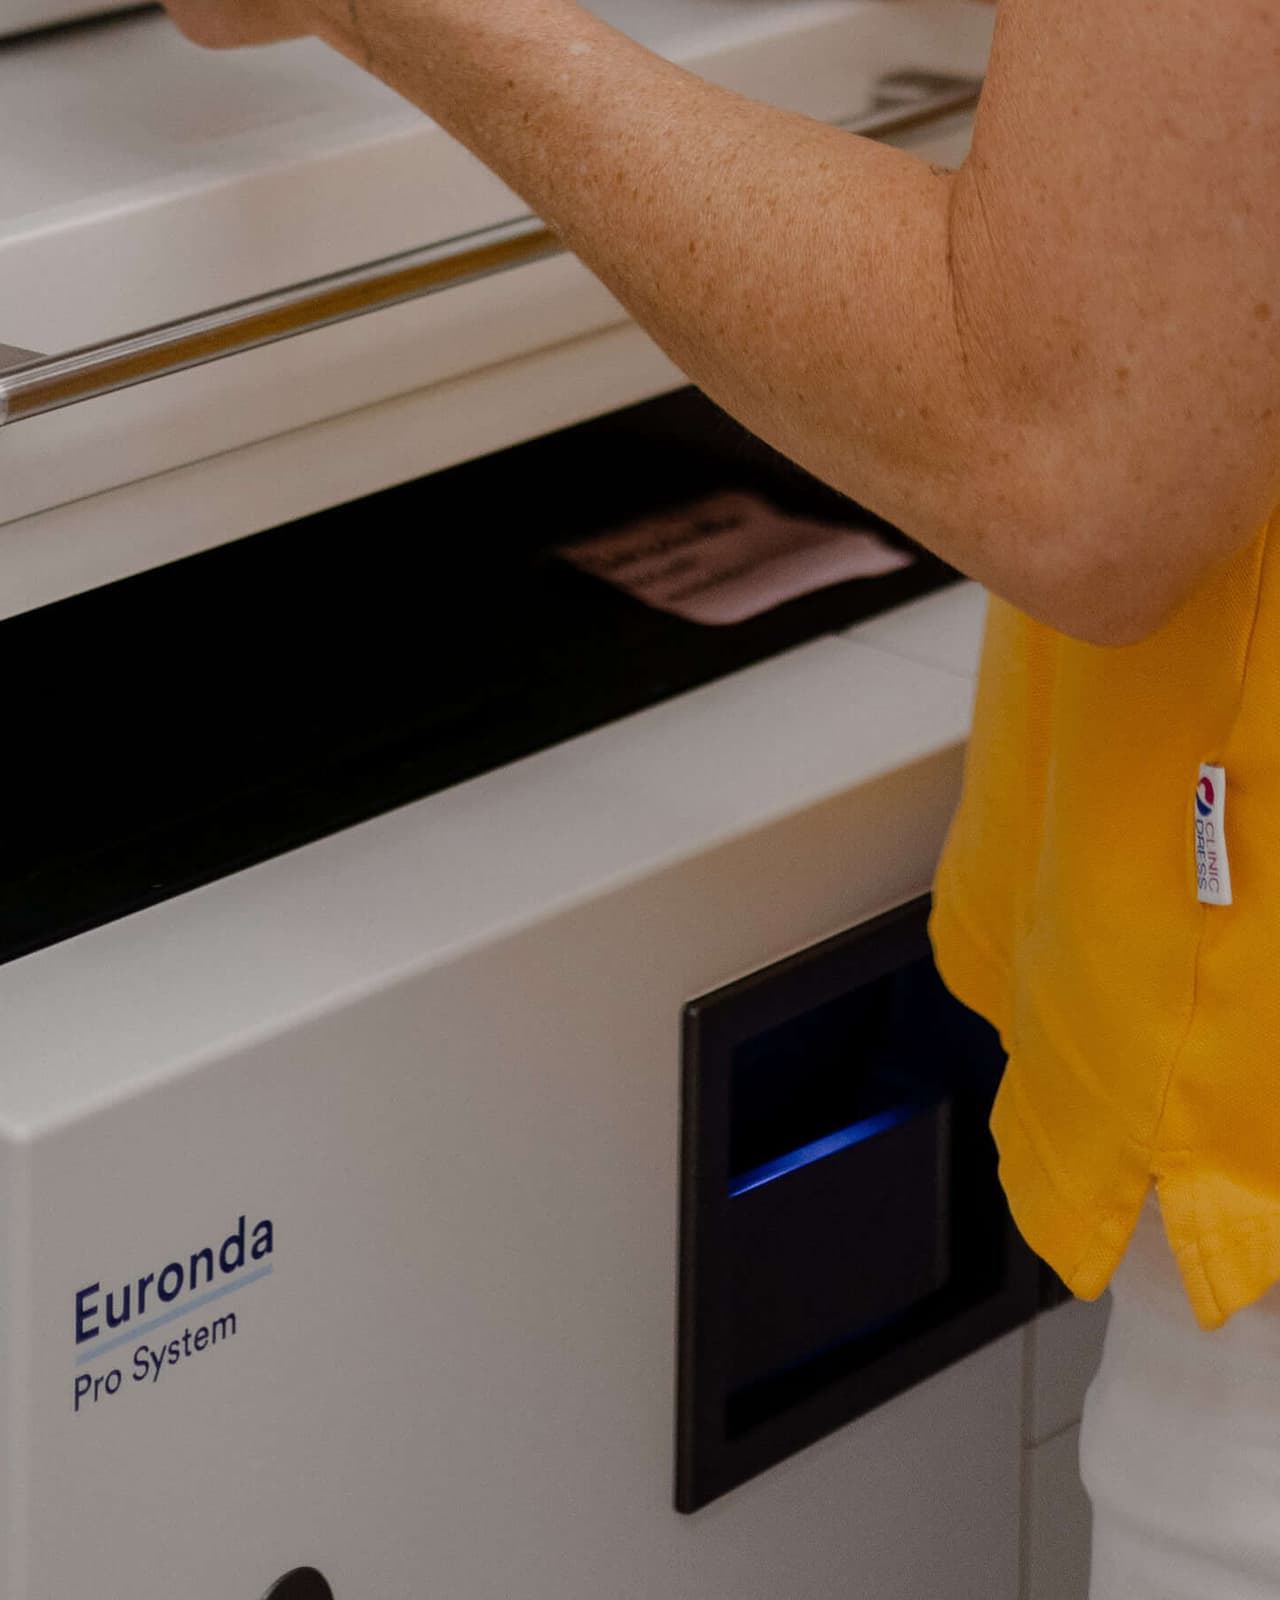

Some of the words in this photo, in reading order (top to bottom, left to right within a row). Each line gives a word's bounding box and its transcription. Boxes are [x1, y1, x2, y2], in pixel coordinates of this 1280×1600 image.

[1205, 821, 1220, 893] CLINIC
[76, 1215, 274, 1344] Euronda
[74, 1369, 122, 1412] Pro
[132, 1312, 237, 1383] System
